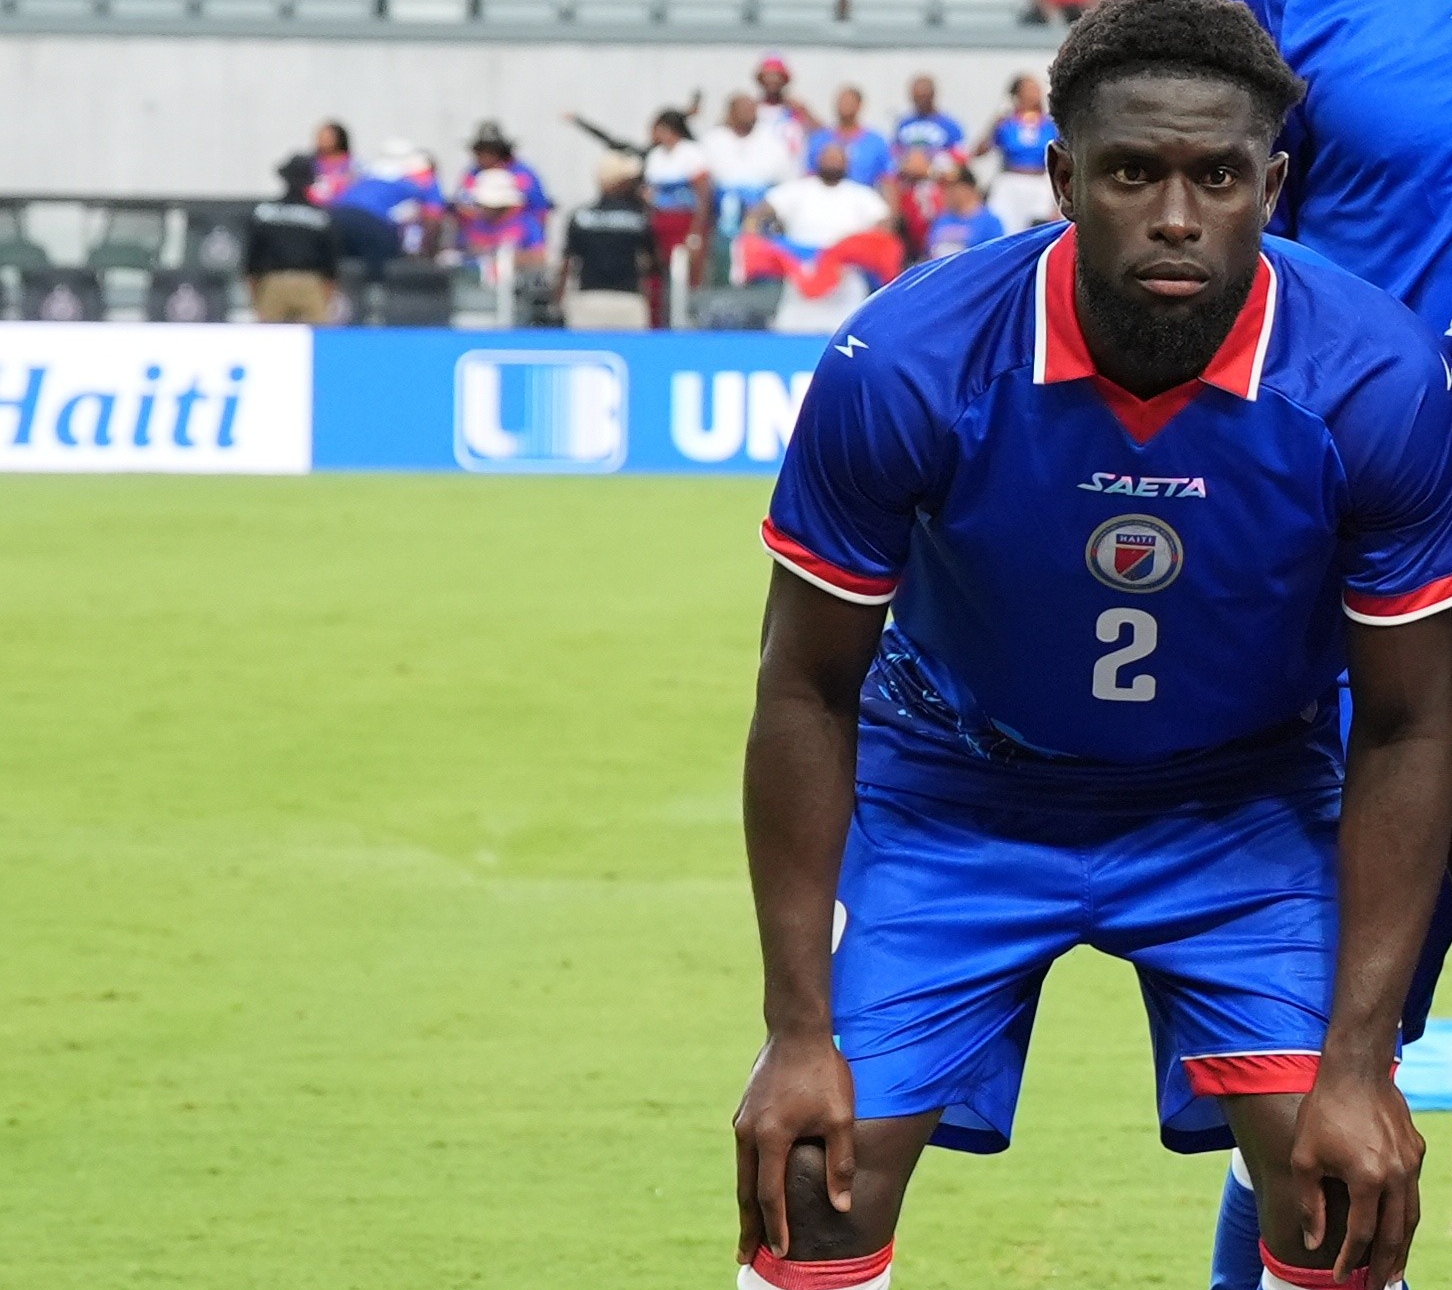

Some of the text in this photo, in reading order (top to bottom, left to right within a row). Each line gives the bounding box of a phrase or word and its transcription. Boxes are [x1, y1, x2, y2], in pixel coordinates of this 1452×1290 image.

[1077, 472, 1206, 498] SAETA
[1118, 534, 1153, 545] HAITI
[1092, 607, 1158, 701] 2
